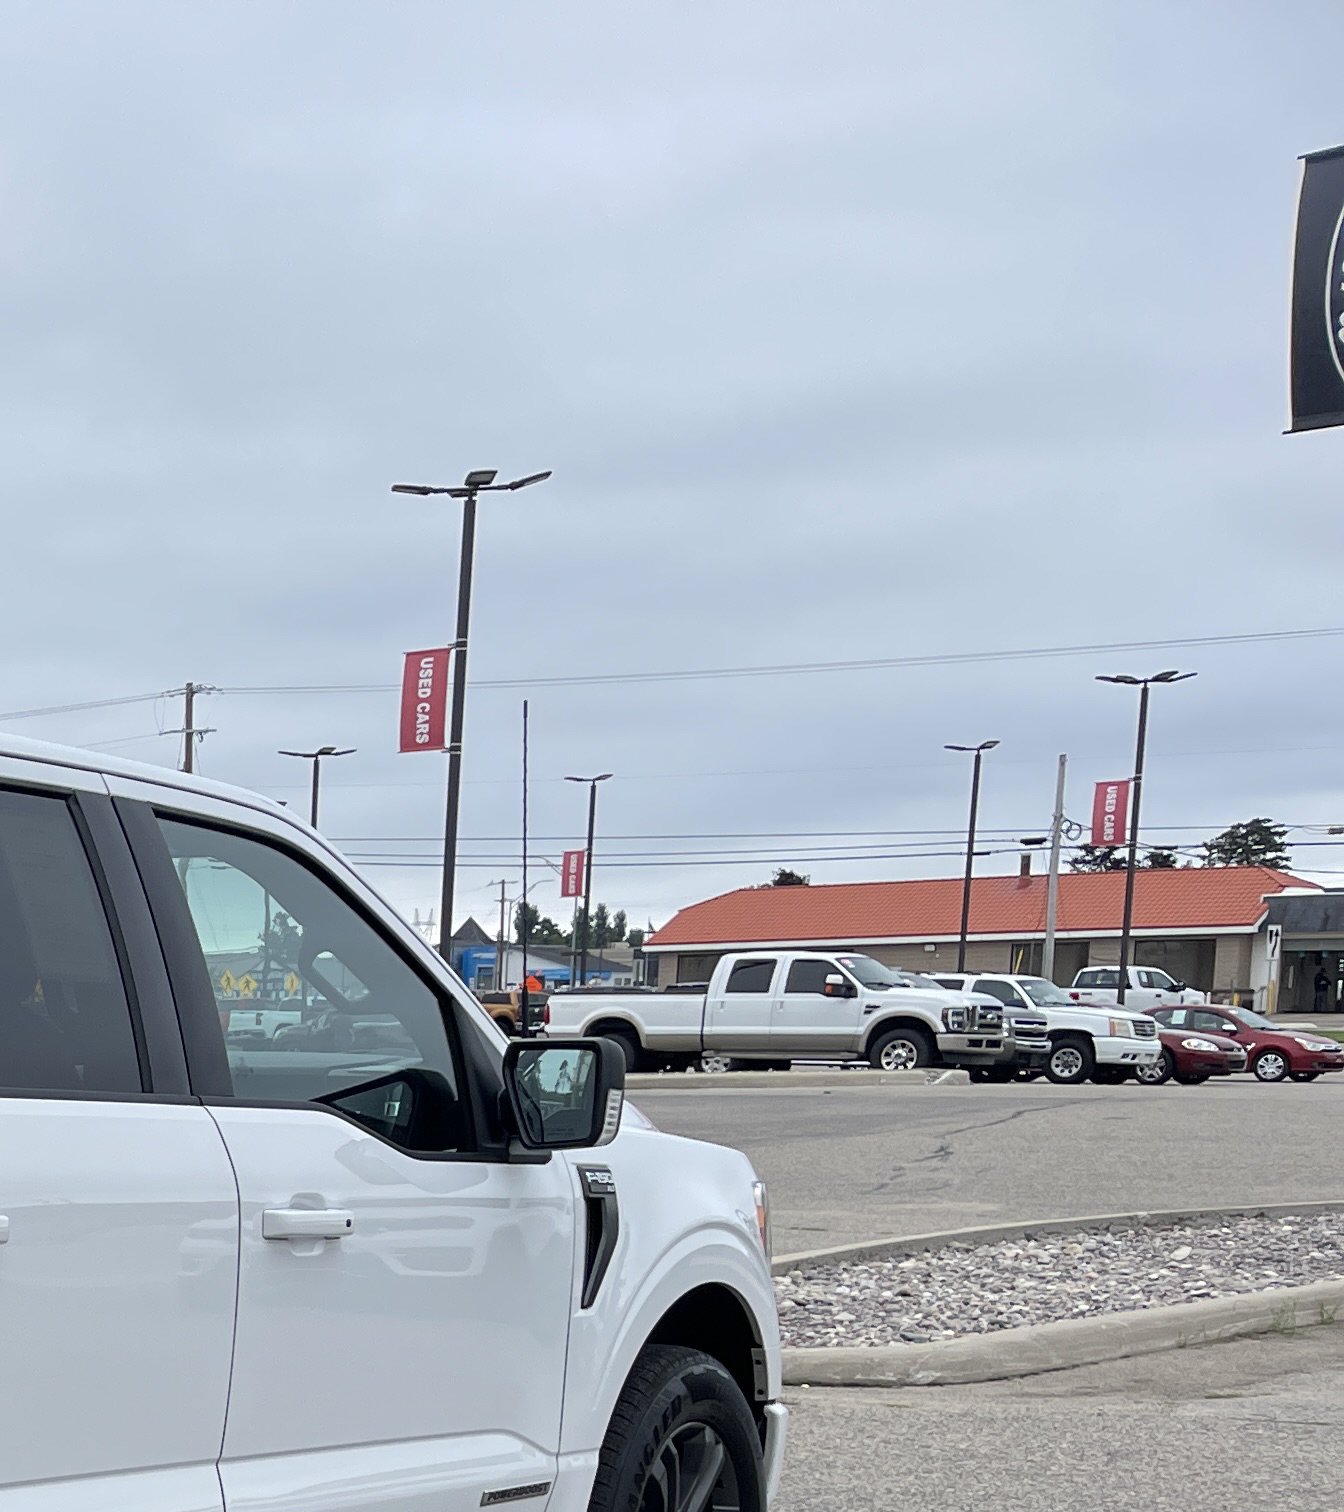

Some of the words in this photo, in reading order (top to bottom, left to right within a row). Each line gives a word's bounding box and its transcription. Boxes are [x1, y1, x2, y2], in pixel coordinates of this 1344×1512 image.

[417, 656, 434, 698] USED
[415, 702, 431, 744] CARS
[1104, 785, 1118, 812] USED
[1104, 814, 1115, 841] CARS
